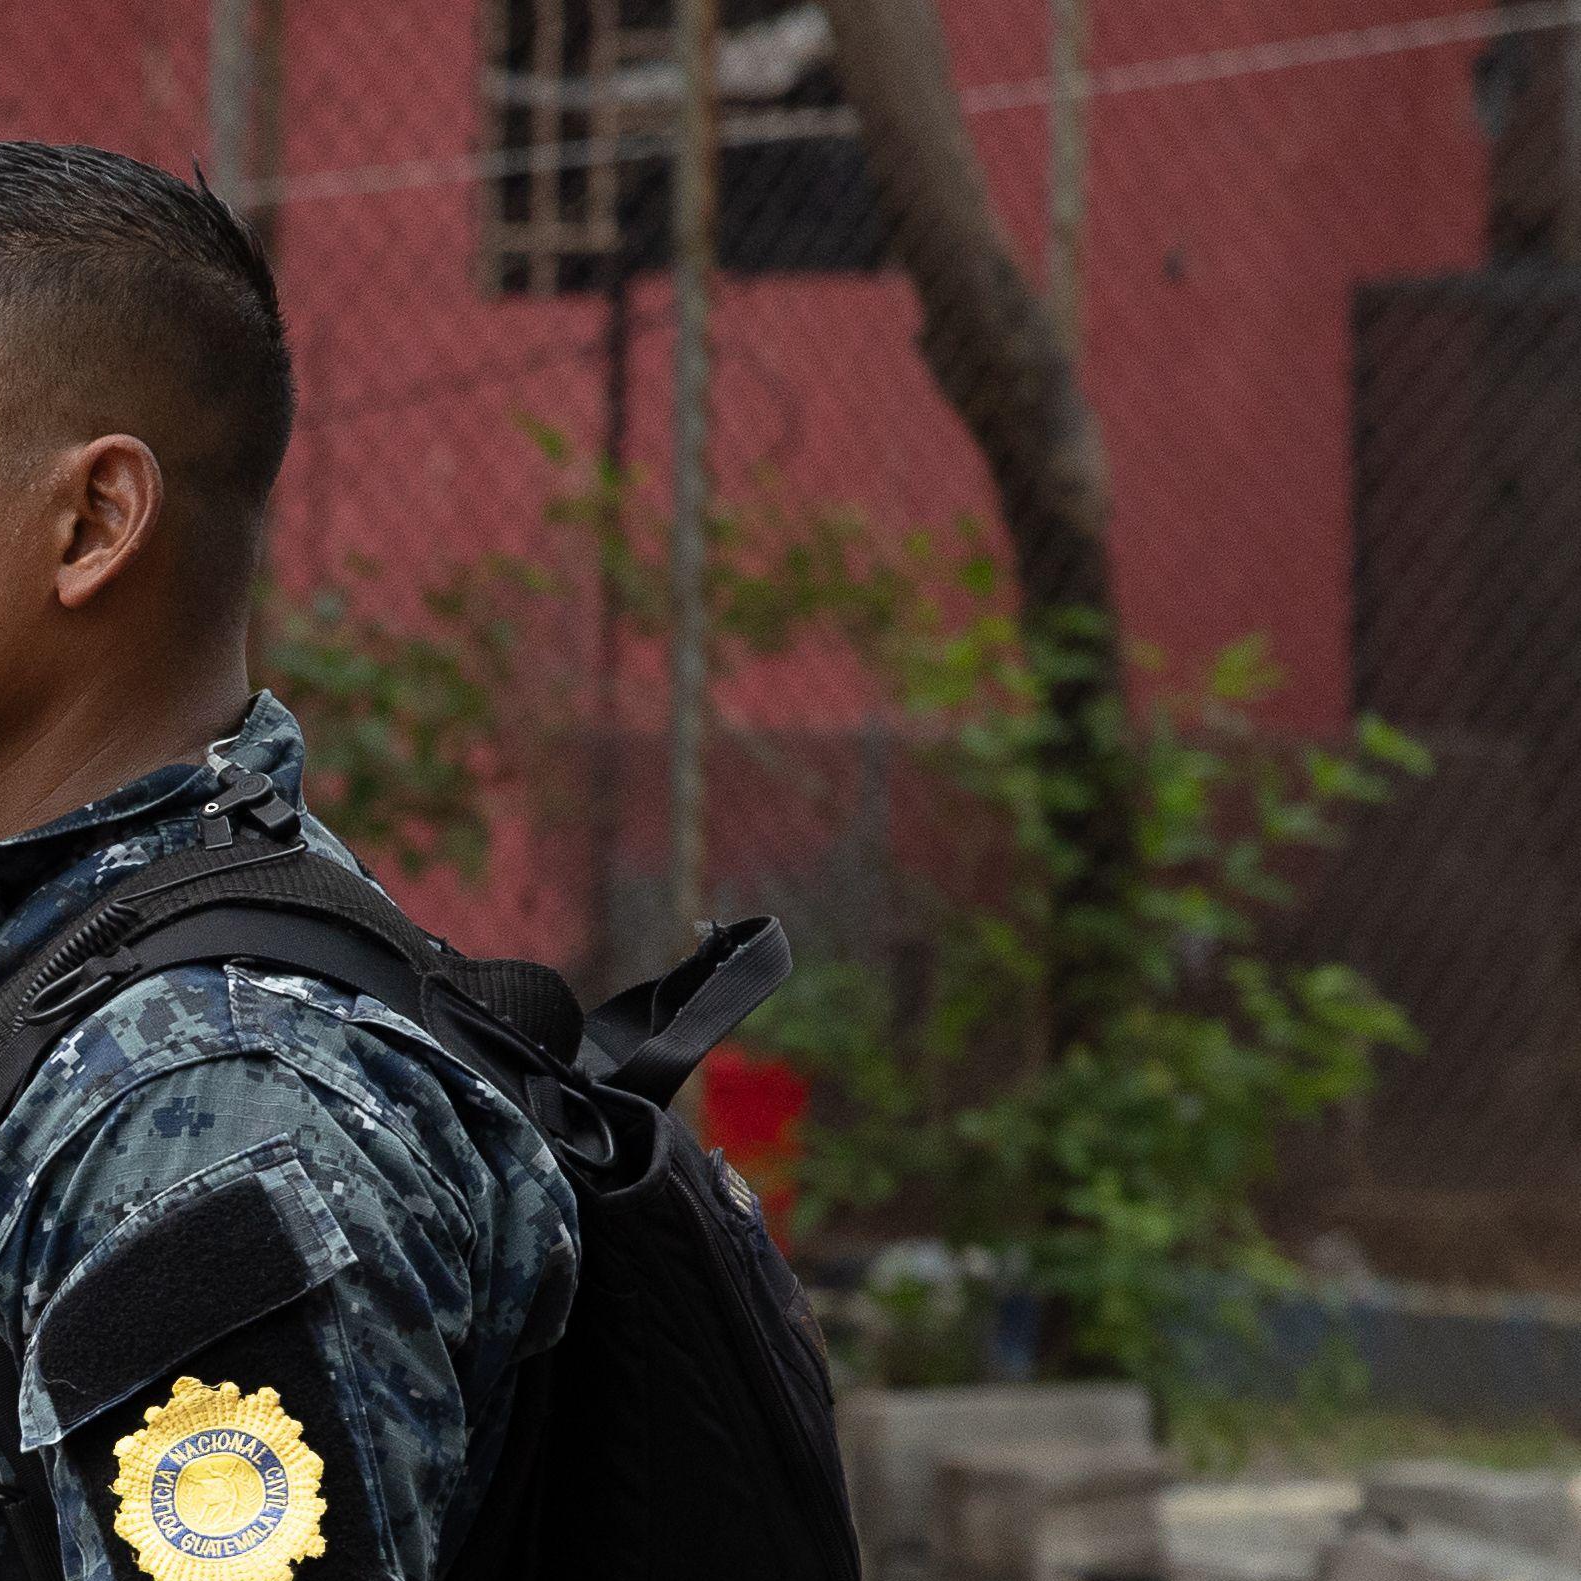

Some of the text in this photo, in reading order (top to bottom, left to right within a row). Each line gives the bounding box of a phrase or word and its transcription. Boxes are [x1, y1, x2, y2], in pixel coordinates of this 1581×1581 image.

[152, 1431, 289, 1539] POLICIA NACIONAL CIVIL
[179, 1514, 279, 1557] GUATEMALA
